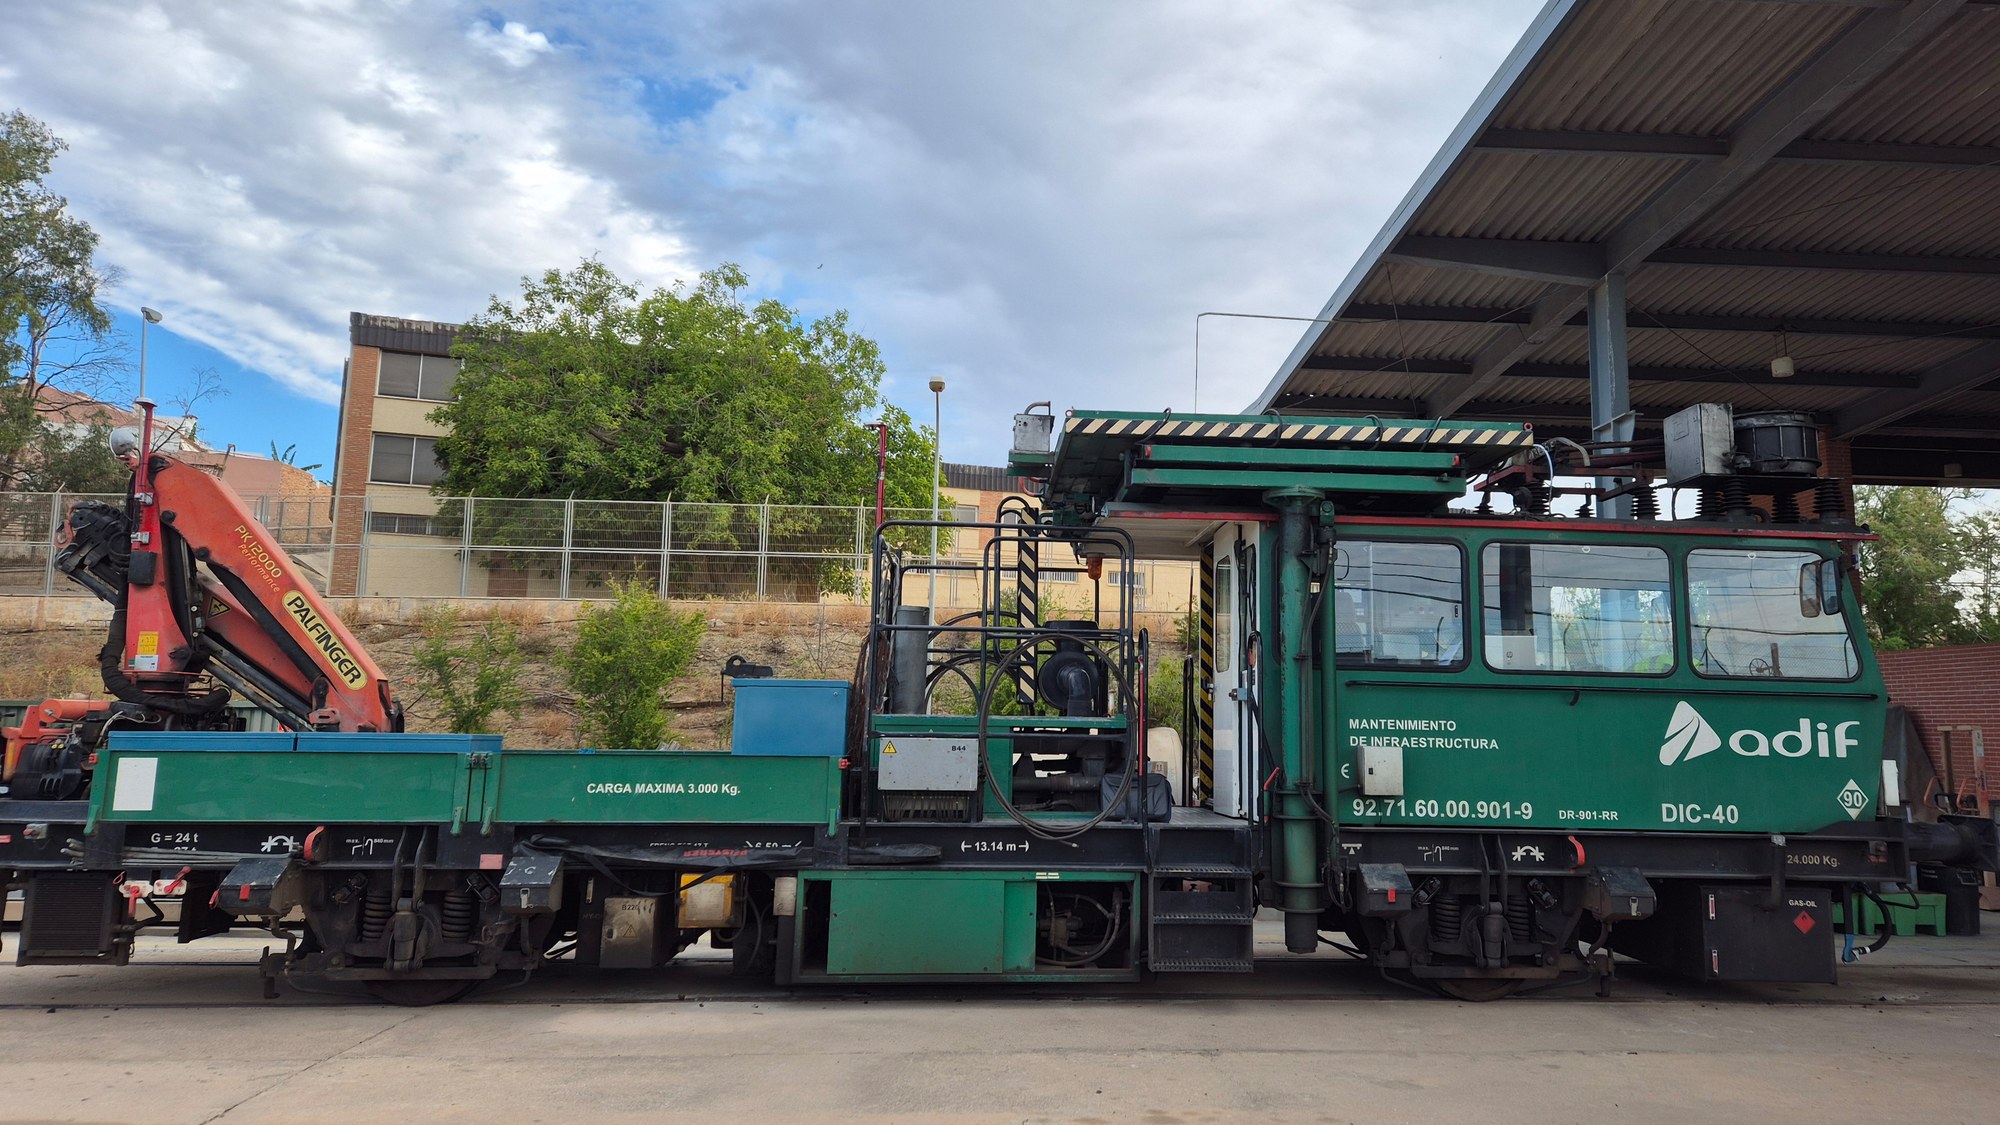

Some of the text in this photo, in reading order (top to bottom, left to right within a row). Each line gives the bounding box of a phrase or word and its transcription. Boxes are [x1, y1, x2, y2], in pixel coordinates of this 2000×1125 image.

[234, 525, 282, 578] PK 12000
[238, 544, 280, 593] Performance
[287, 596, 362, 684] PALFINGER
[1349, 718, 1457, 731] MANTENIMIENTO
[1350, 736, 1499, 750] DE INFRAESTRUCTURA
[1728, 718, 1860, 758] adif
[586, 783, 741, 796] CARGA MAXIMA 3.000 Kg.
[1843, 791, 1862, 807] 90
[1353, 799, 1619, 821] 92.71.60.00.901-9 DR-901-RR
[1661, 803, 1739, 824] DIC-40
[151, 832, 161, 843] G
[175, 832, 190, 843] 24
[193, 832, 199, 843] t
[974, 841, 1017, 852] 13.14 m
[1787, 854, 1841, 867] 24.000 Kg.
[1788, 899, 1818, 908] GAS-OIL
